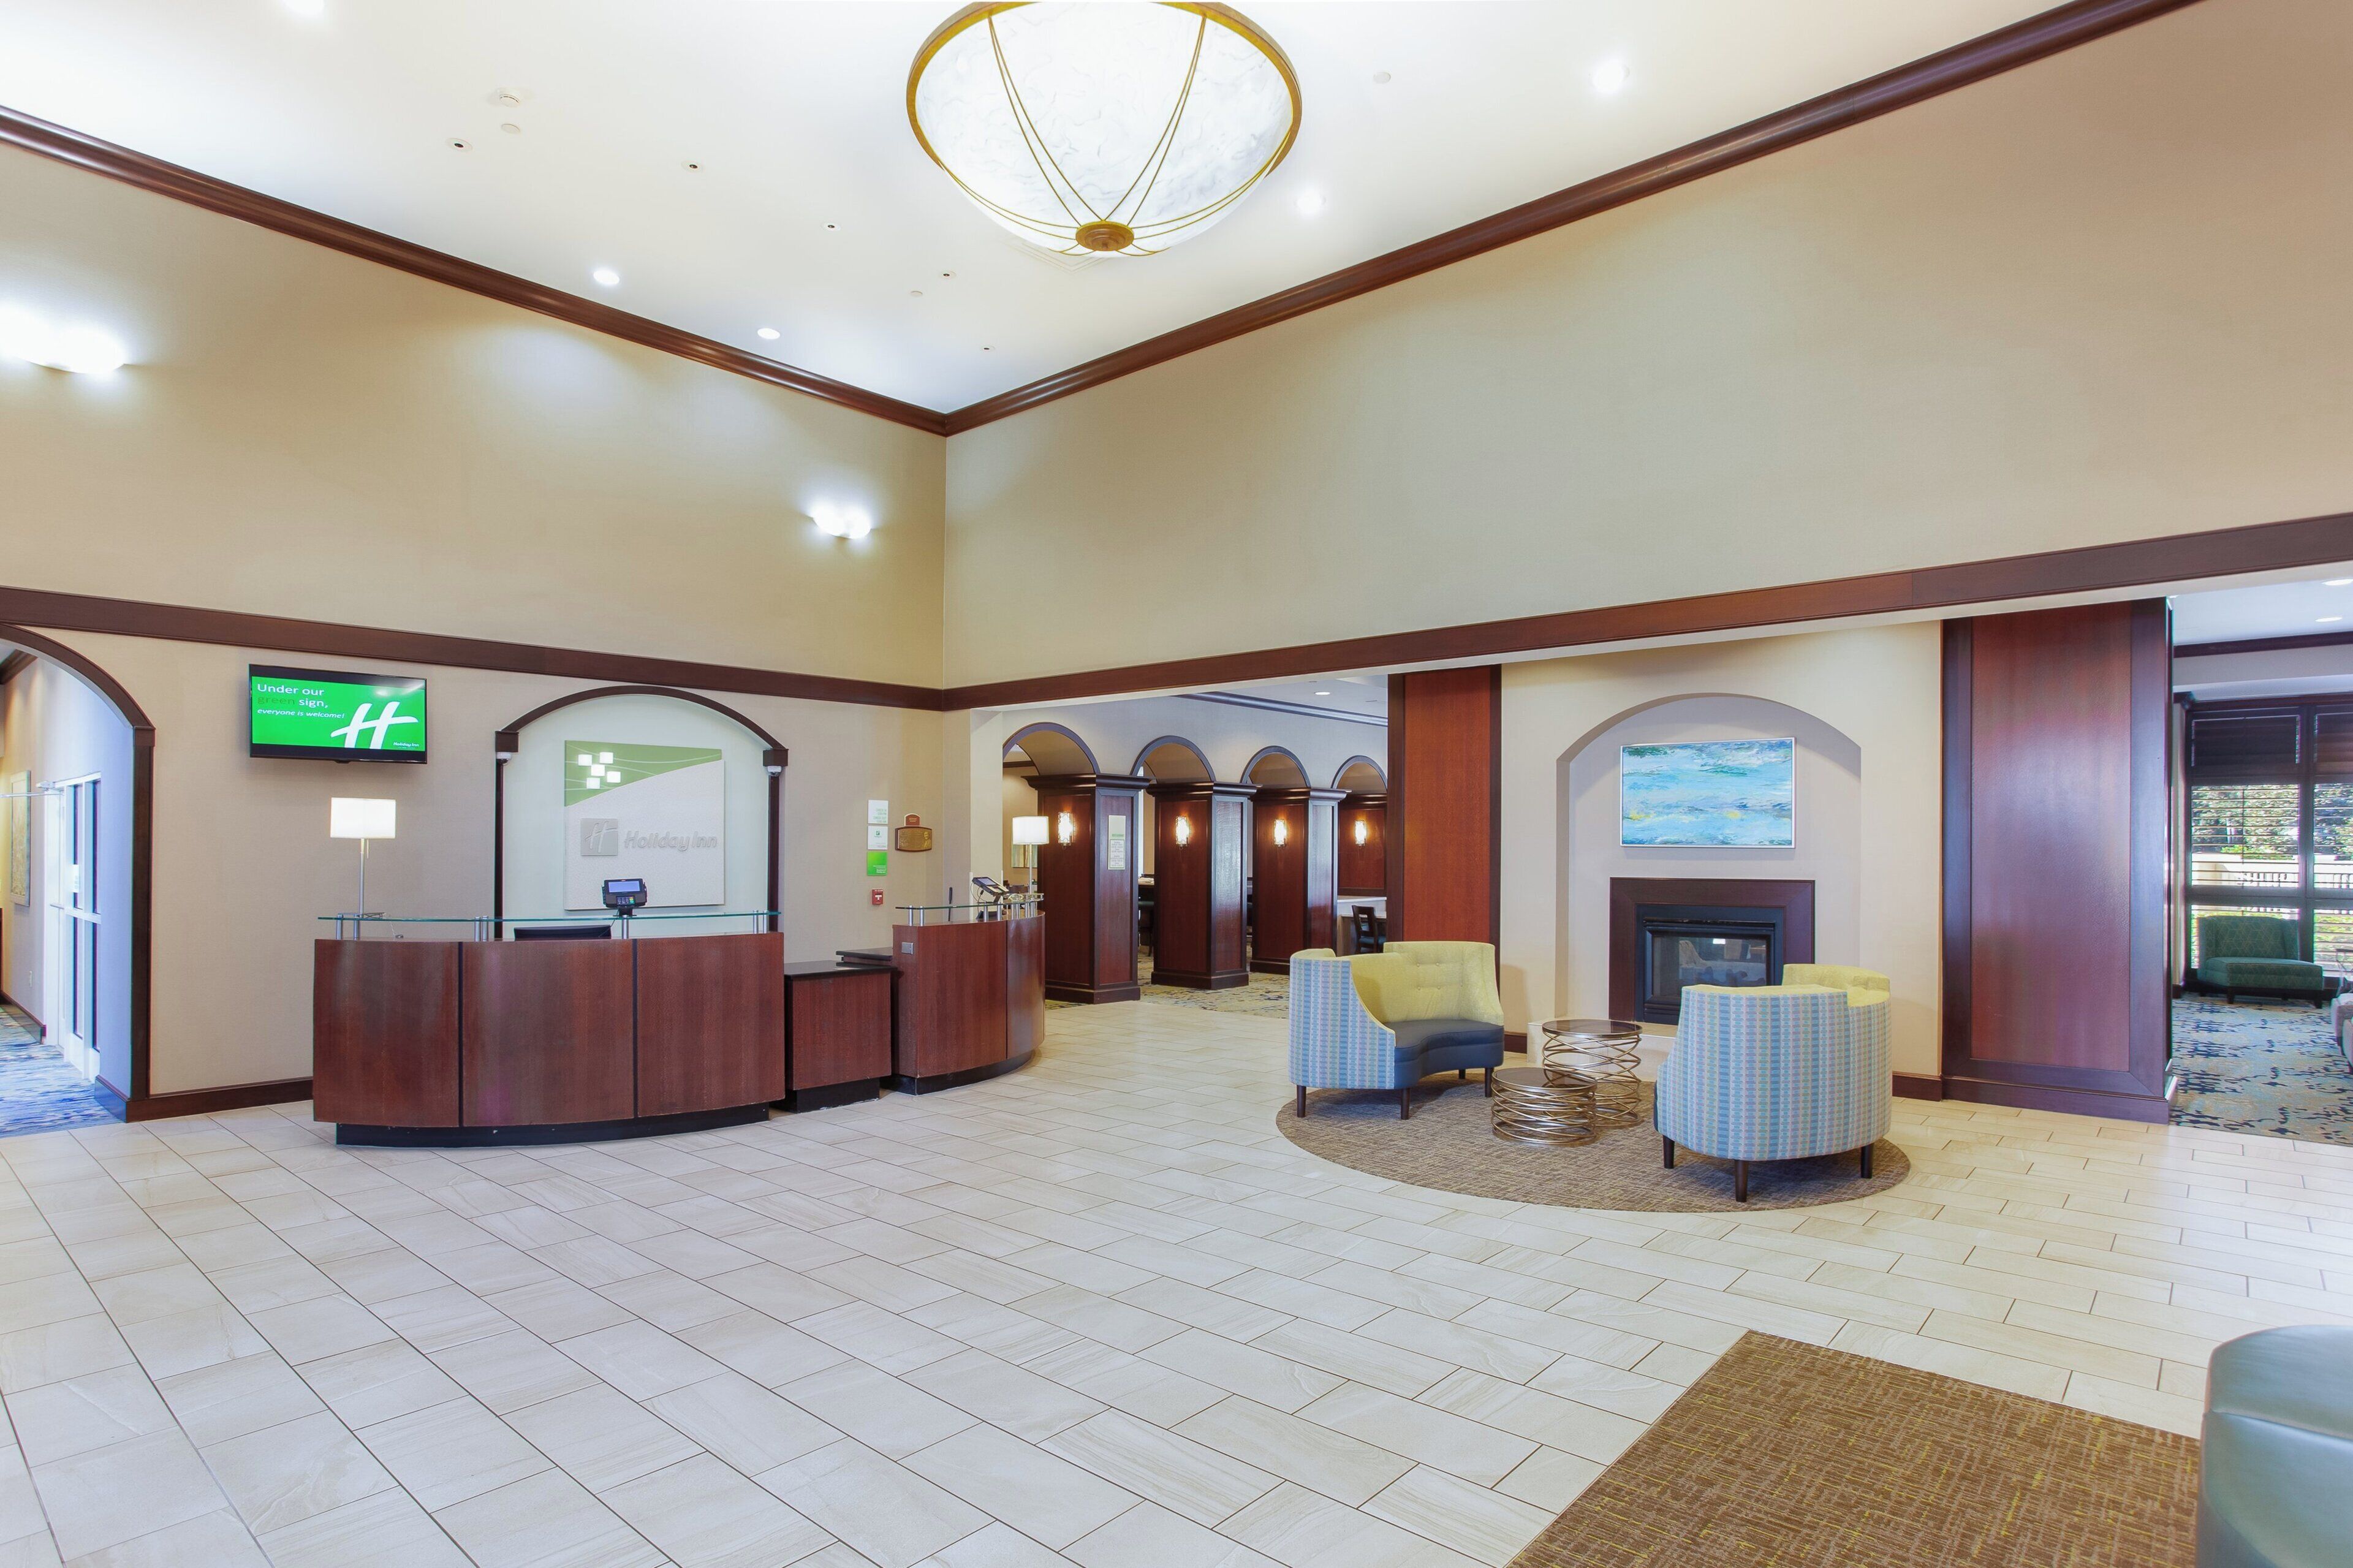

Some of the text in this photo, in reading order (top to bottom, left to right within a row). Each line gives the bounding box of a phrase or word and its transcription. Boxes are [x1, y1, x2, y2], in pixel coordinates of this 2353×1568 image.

[257, 684, 299, 694] Under
[257, 696, 328, 708] green sign,
[624, 830, 718, 852] Holiday Inn
